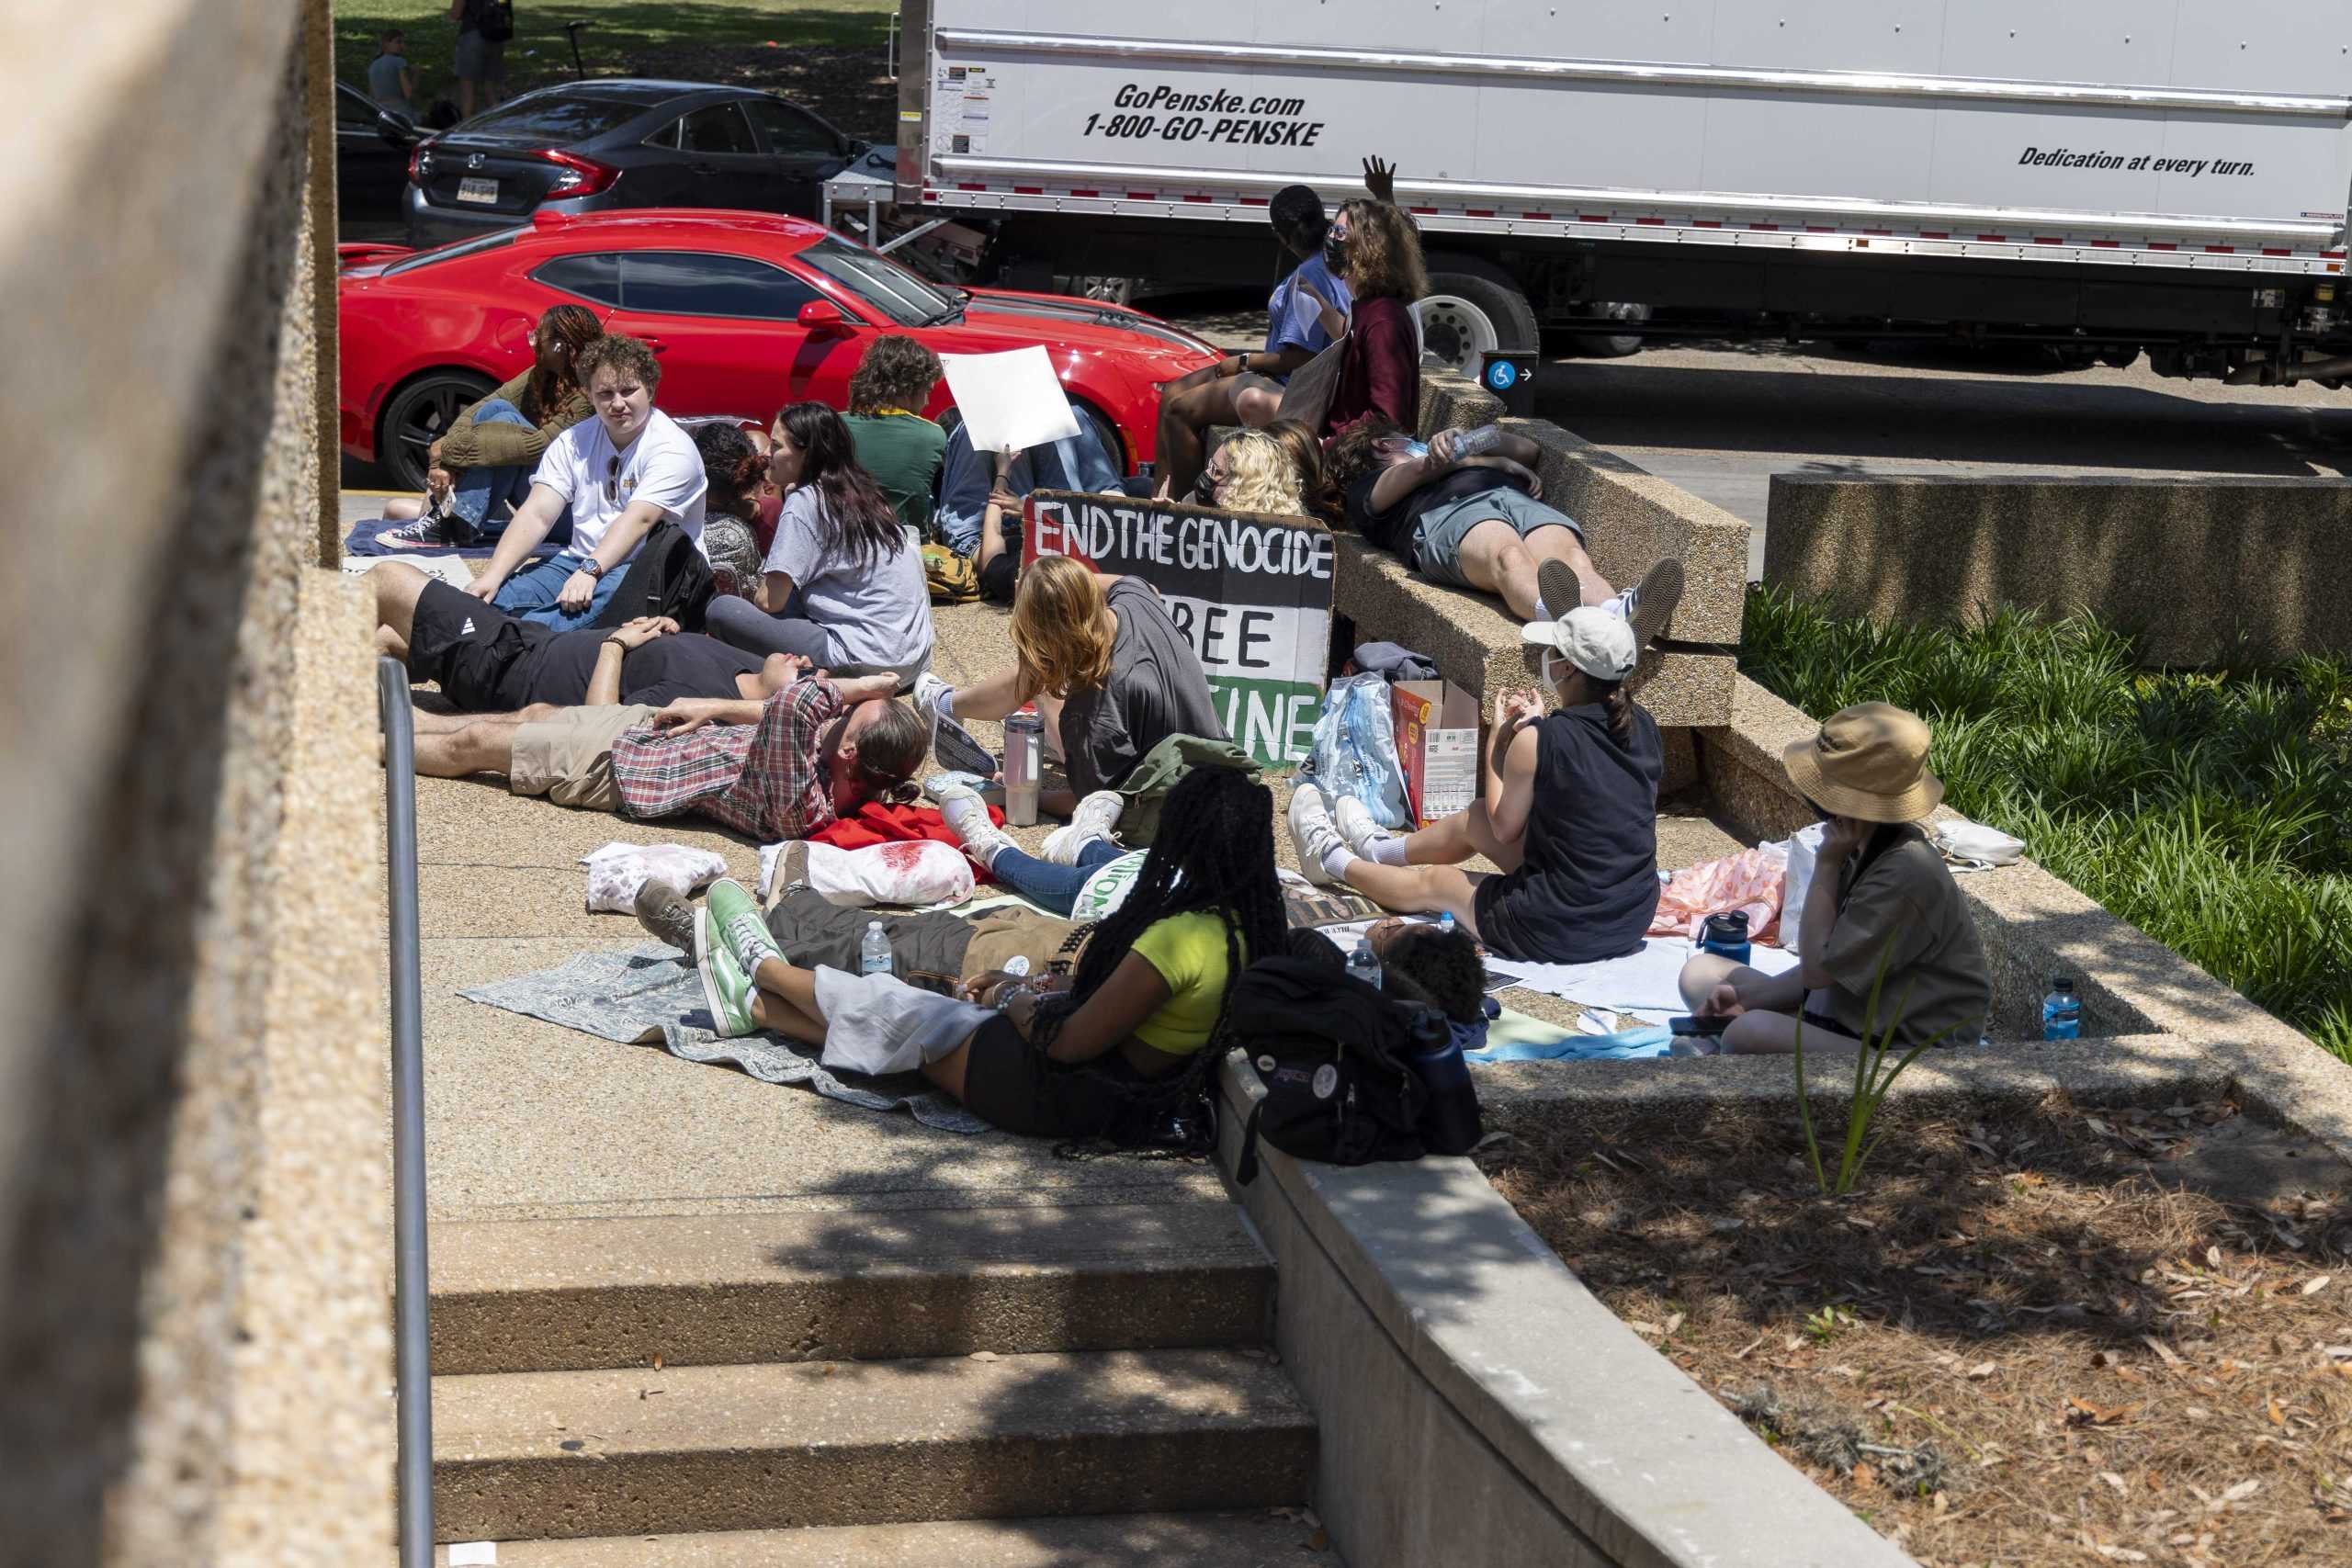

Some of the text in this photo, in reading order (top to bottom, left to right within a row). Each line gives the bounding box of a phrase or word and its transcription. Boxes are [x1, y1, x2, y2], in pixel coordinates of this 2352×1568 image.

[1114, 84, 1306, 116] GoPenske.com
[1083, 113, 1325, 147] 1-800-GO-PENSKE
[2018, 147, 2256, 177] Dedication at every turn.
[1035, 502, 1334, 579] END THE GENOCIDE
[1159, 598, 1274, 668] REE
